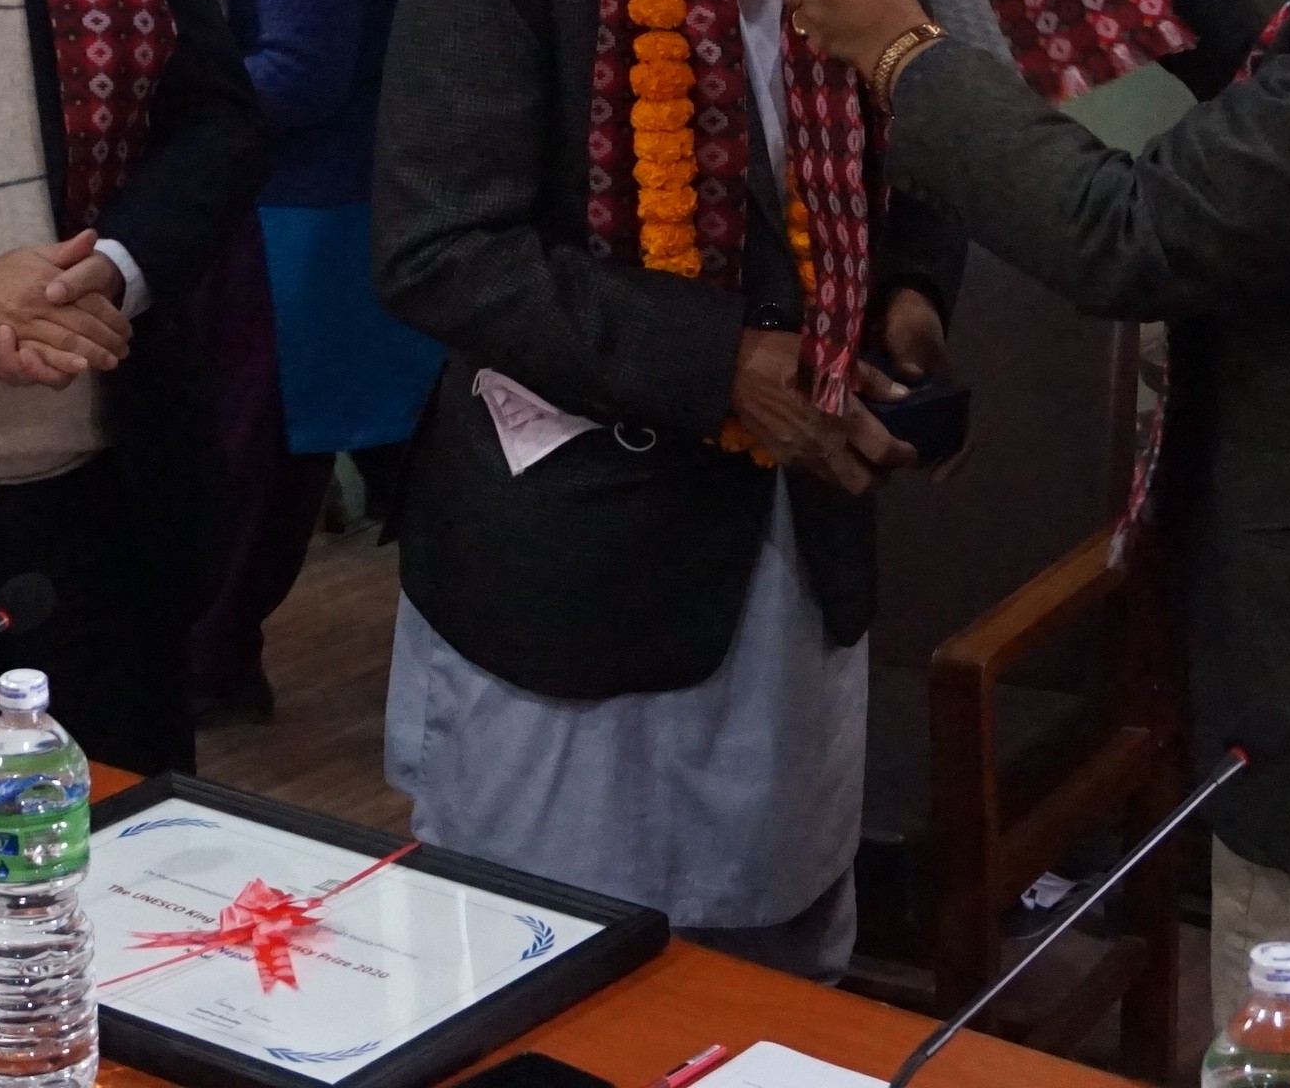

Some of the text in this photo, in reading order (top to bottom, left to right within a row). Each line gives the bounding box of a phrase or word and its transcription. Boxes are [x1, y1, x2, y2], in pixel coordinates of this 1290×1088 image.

[107, 884, 131, 896] The
[131, 891, 186, 913] UNESCO
[185, 910, 216, 925] King
[317, 952, 352, 968] Prize
[352, 963, 390, 980] 2020
